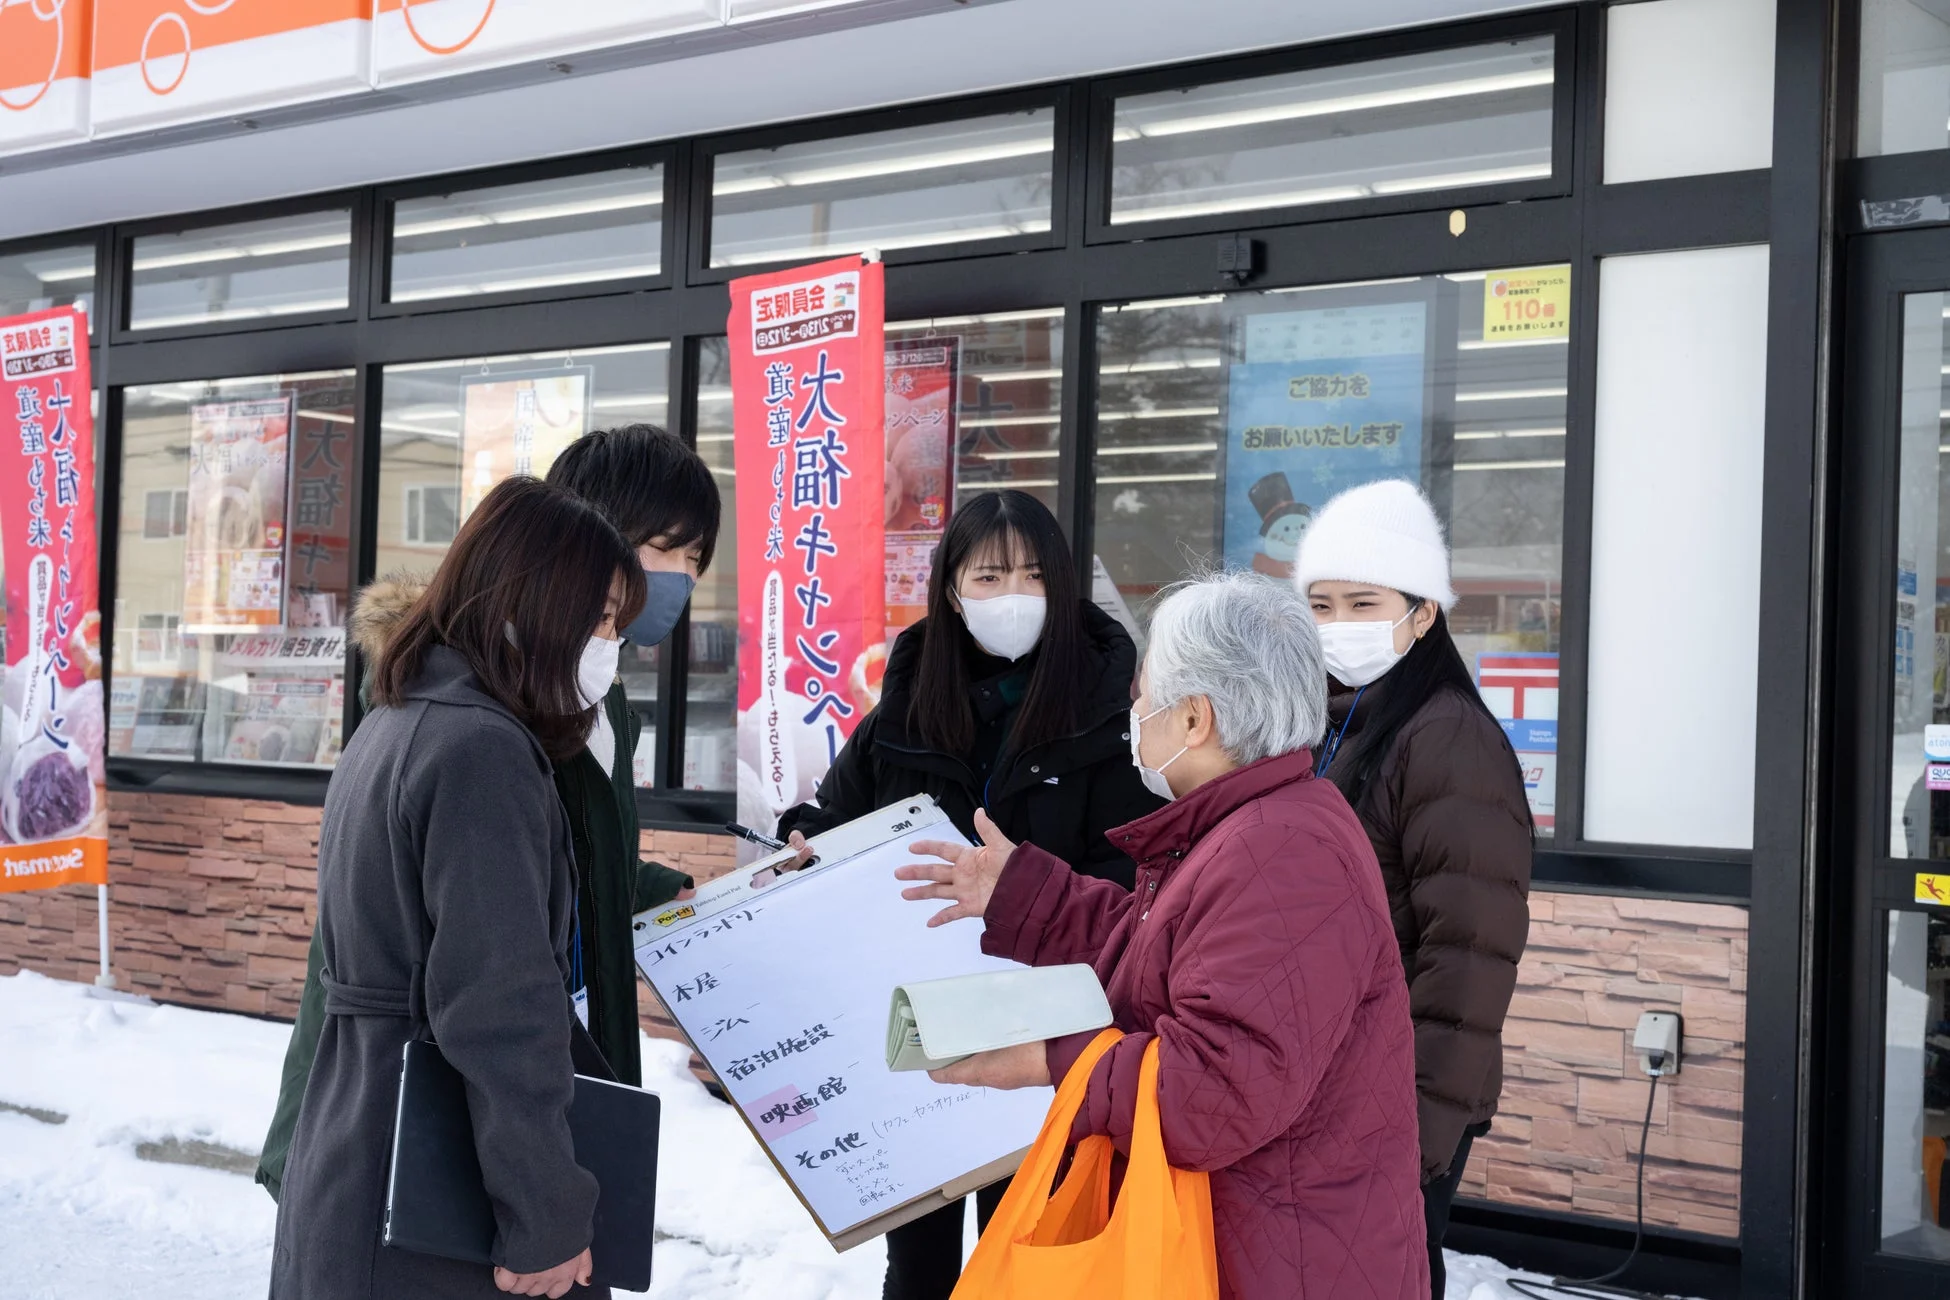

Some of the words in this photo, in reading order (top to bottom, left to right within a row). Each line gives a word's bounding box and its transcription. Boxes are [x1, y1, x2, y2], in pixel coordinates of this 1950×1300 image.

[1503, 298, 1555, 320] 110番
[1289, 376, 1368, 398] ご協力を
[1244, 423, 1401, 449] お願いいたします
[891, 820, 913, 832] 3M
[657, 905, 692, 924] Post-it
[647, 908, 764, 967] コインランドリー
[672, 971, 720, 1003] 本屋
[700, 1017, 750, 1042] ジム
[725, 1023, 835, 1081] 宿泊施設
[759, 1076, 847, 1124] 映画館
[795, 1132, 868, 1169] その他
